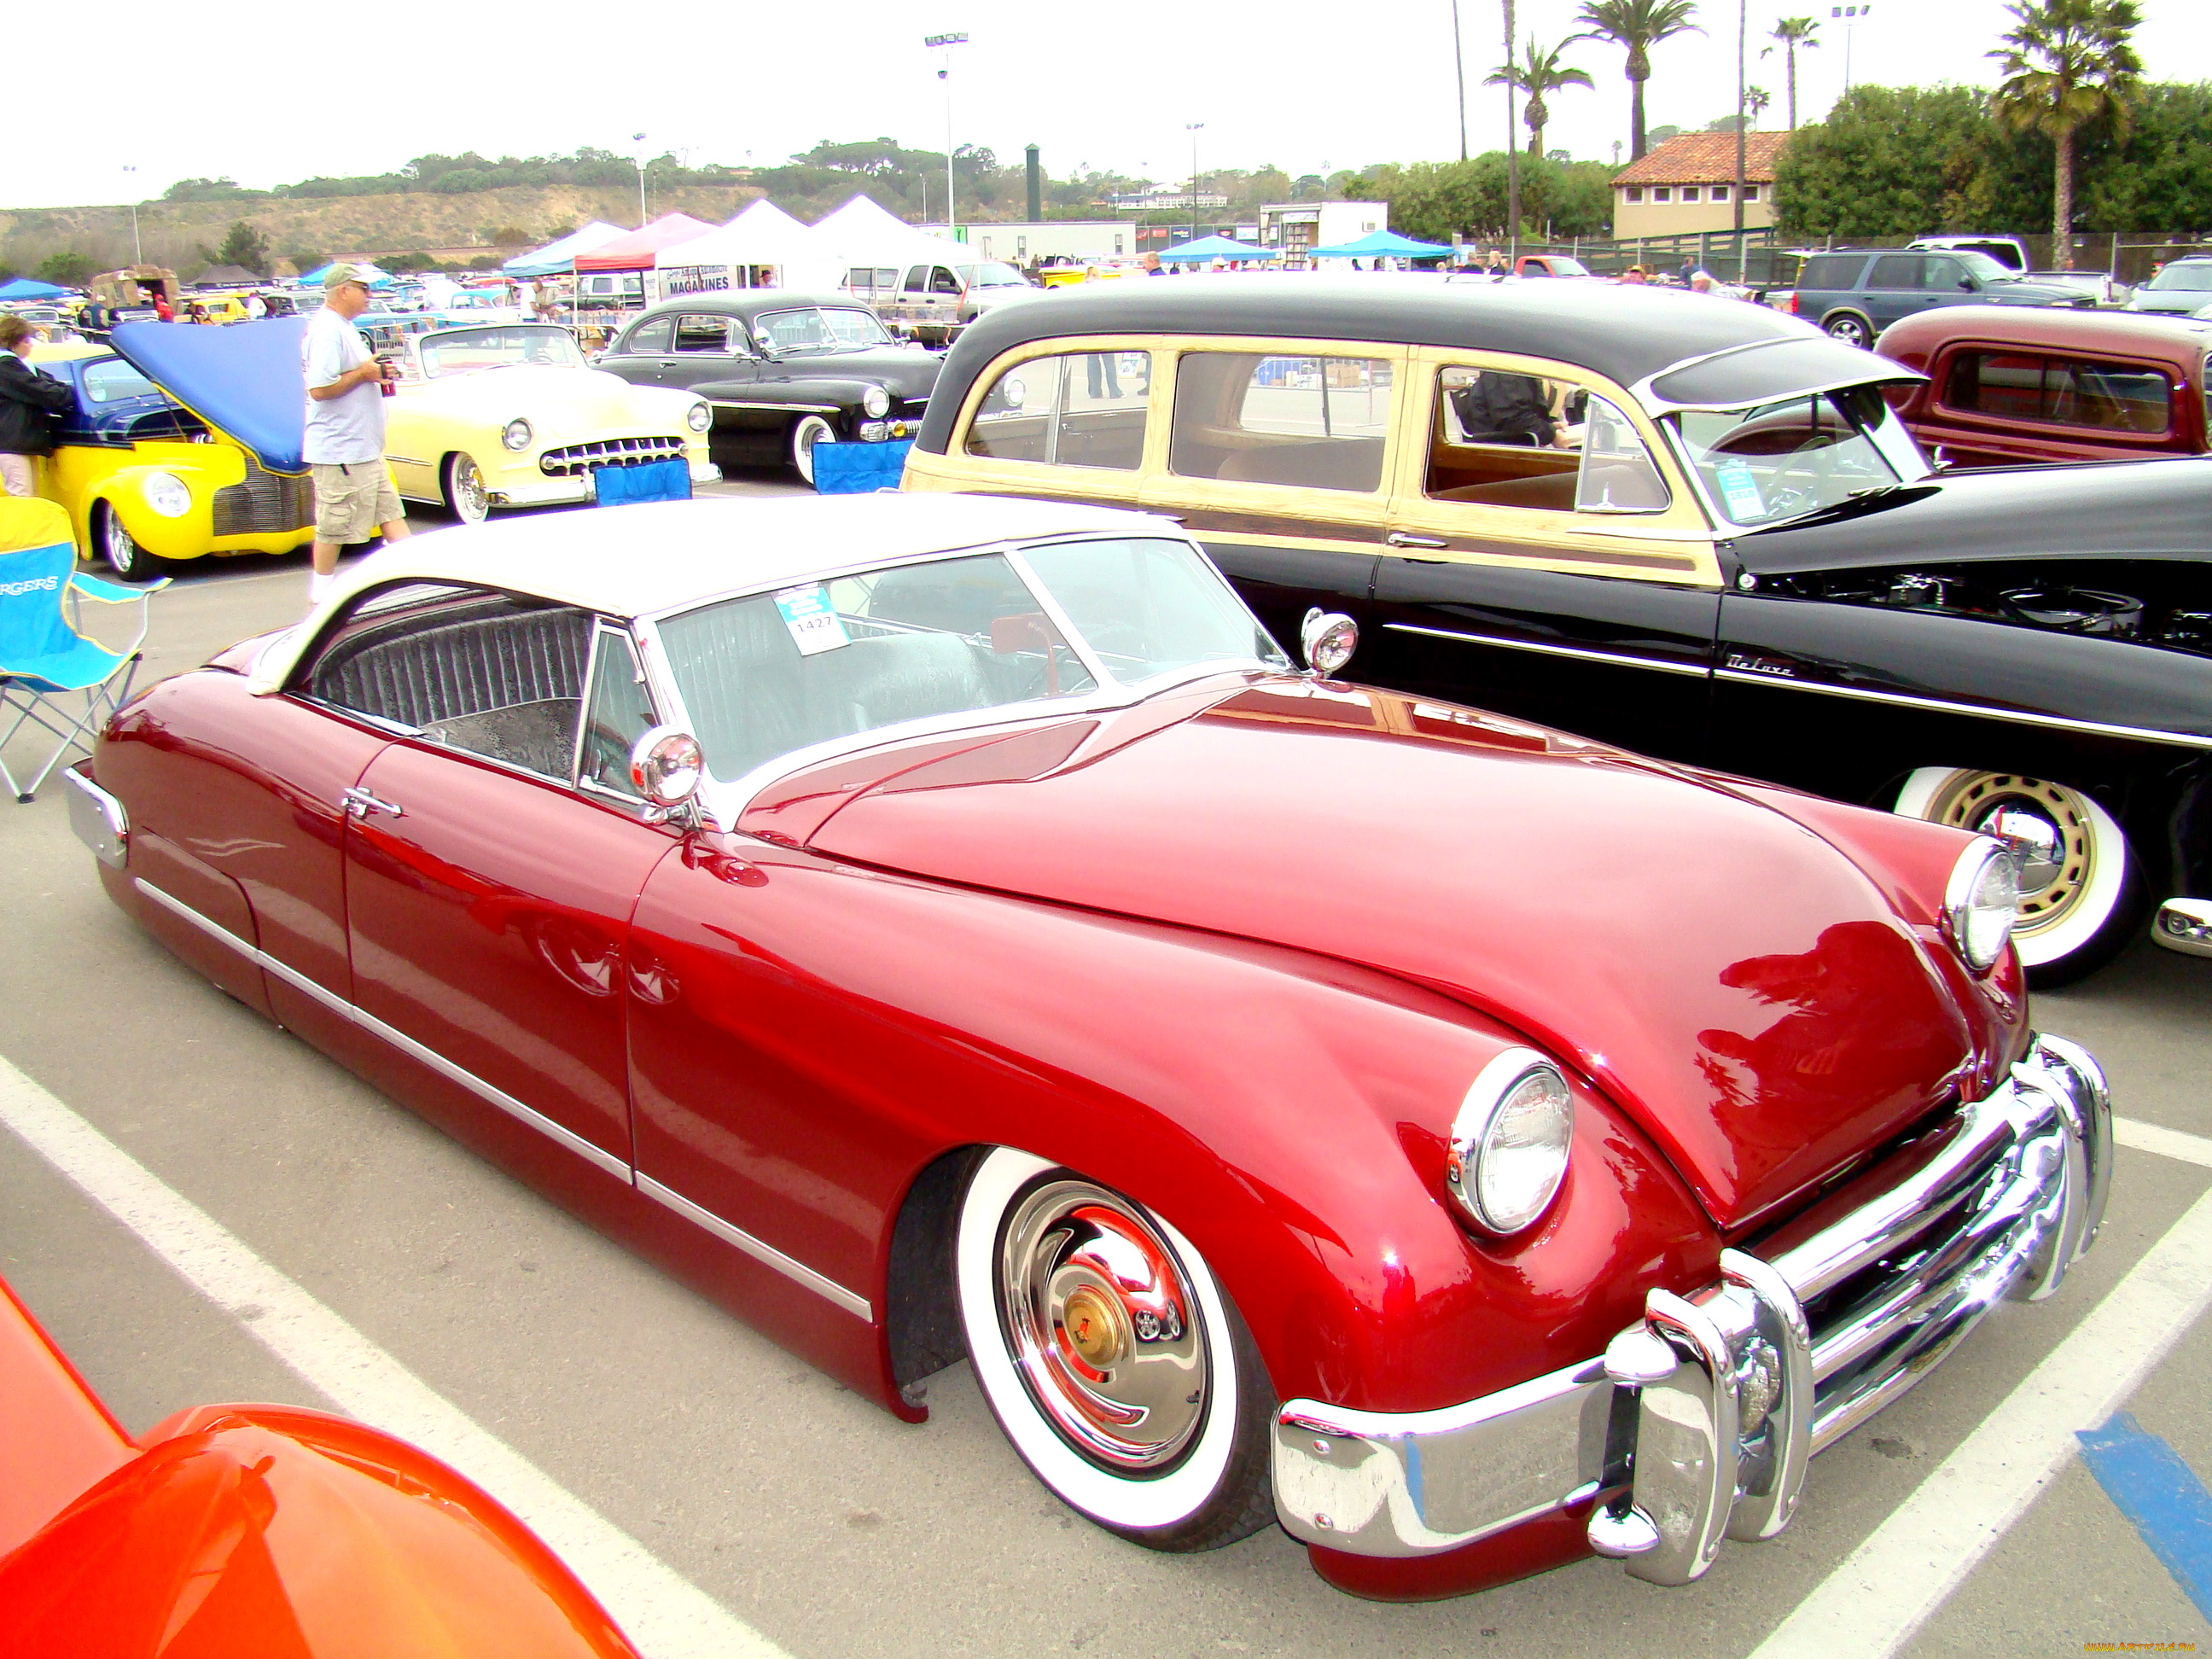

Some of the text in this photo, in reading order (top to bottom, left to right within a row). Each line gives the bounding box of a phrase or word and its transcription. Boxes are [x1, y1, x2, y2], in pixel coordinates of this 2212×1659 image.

[670, 276, 729, 294] MAGAZINES
[0, 576, 58, 596] RGERS
[798, 616, 831, 632] 1427
